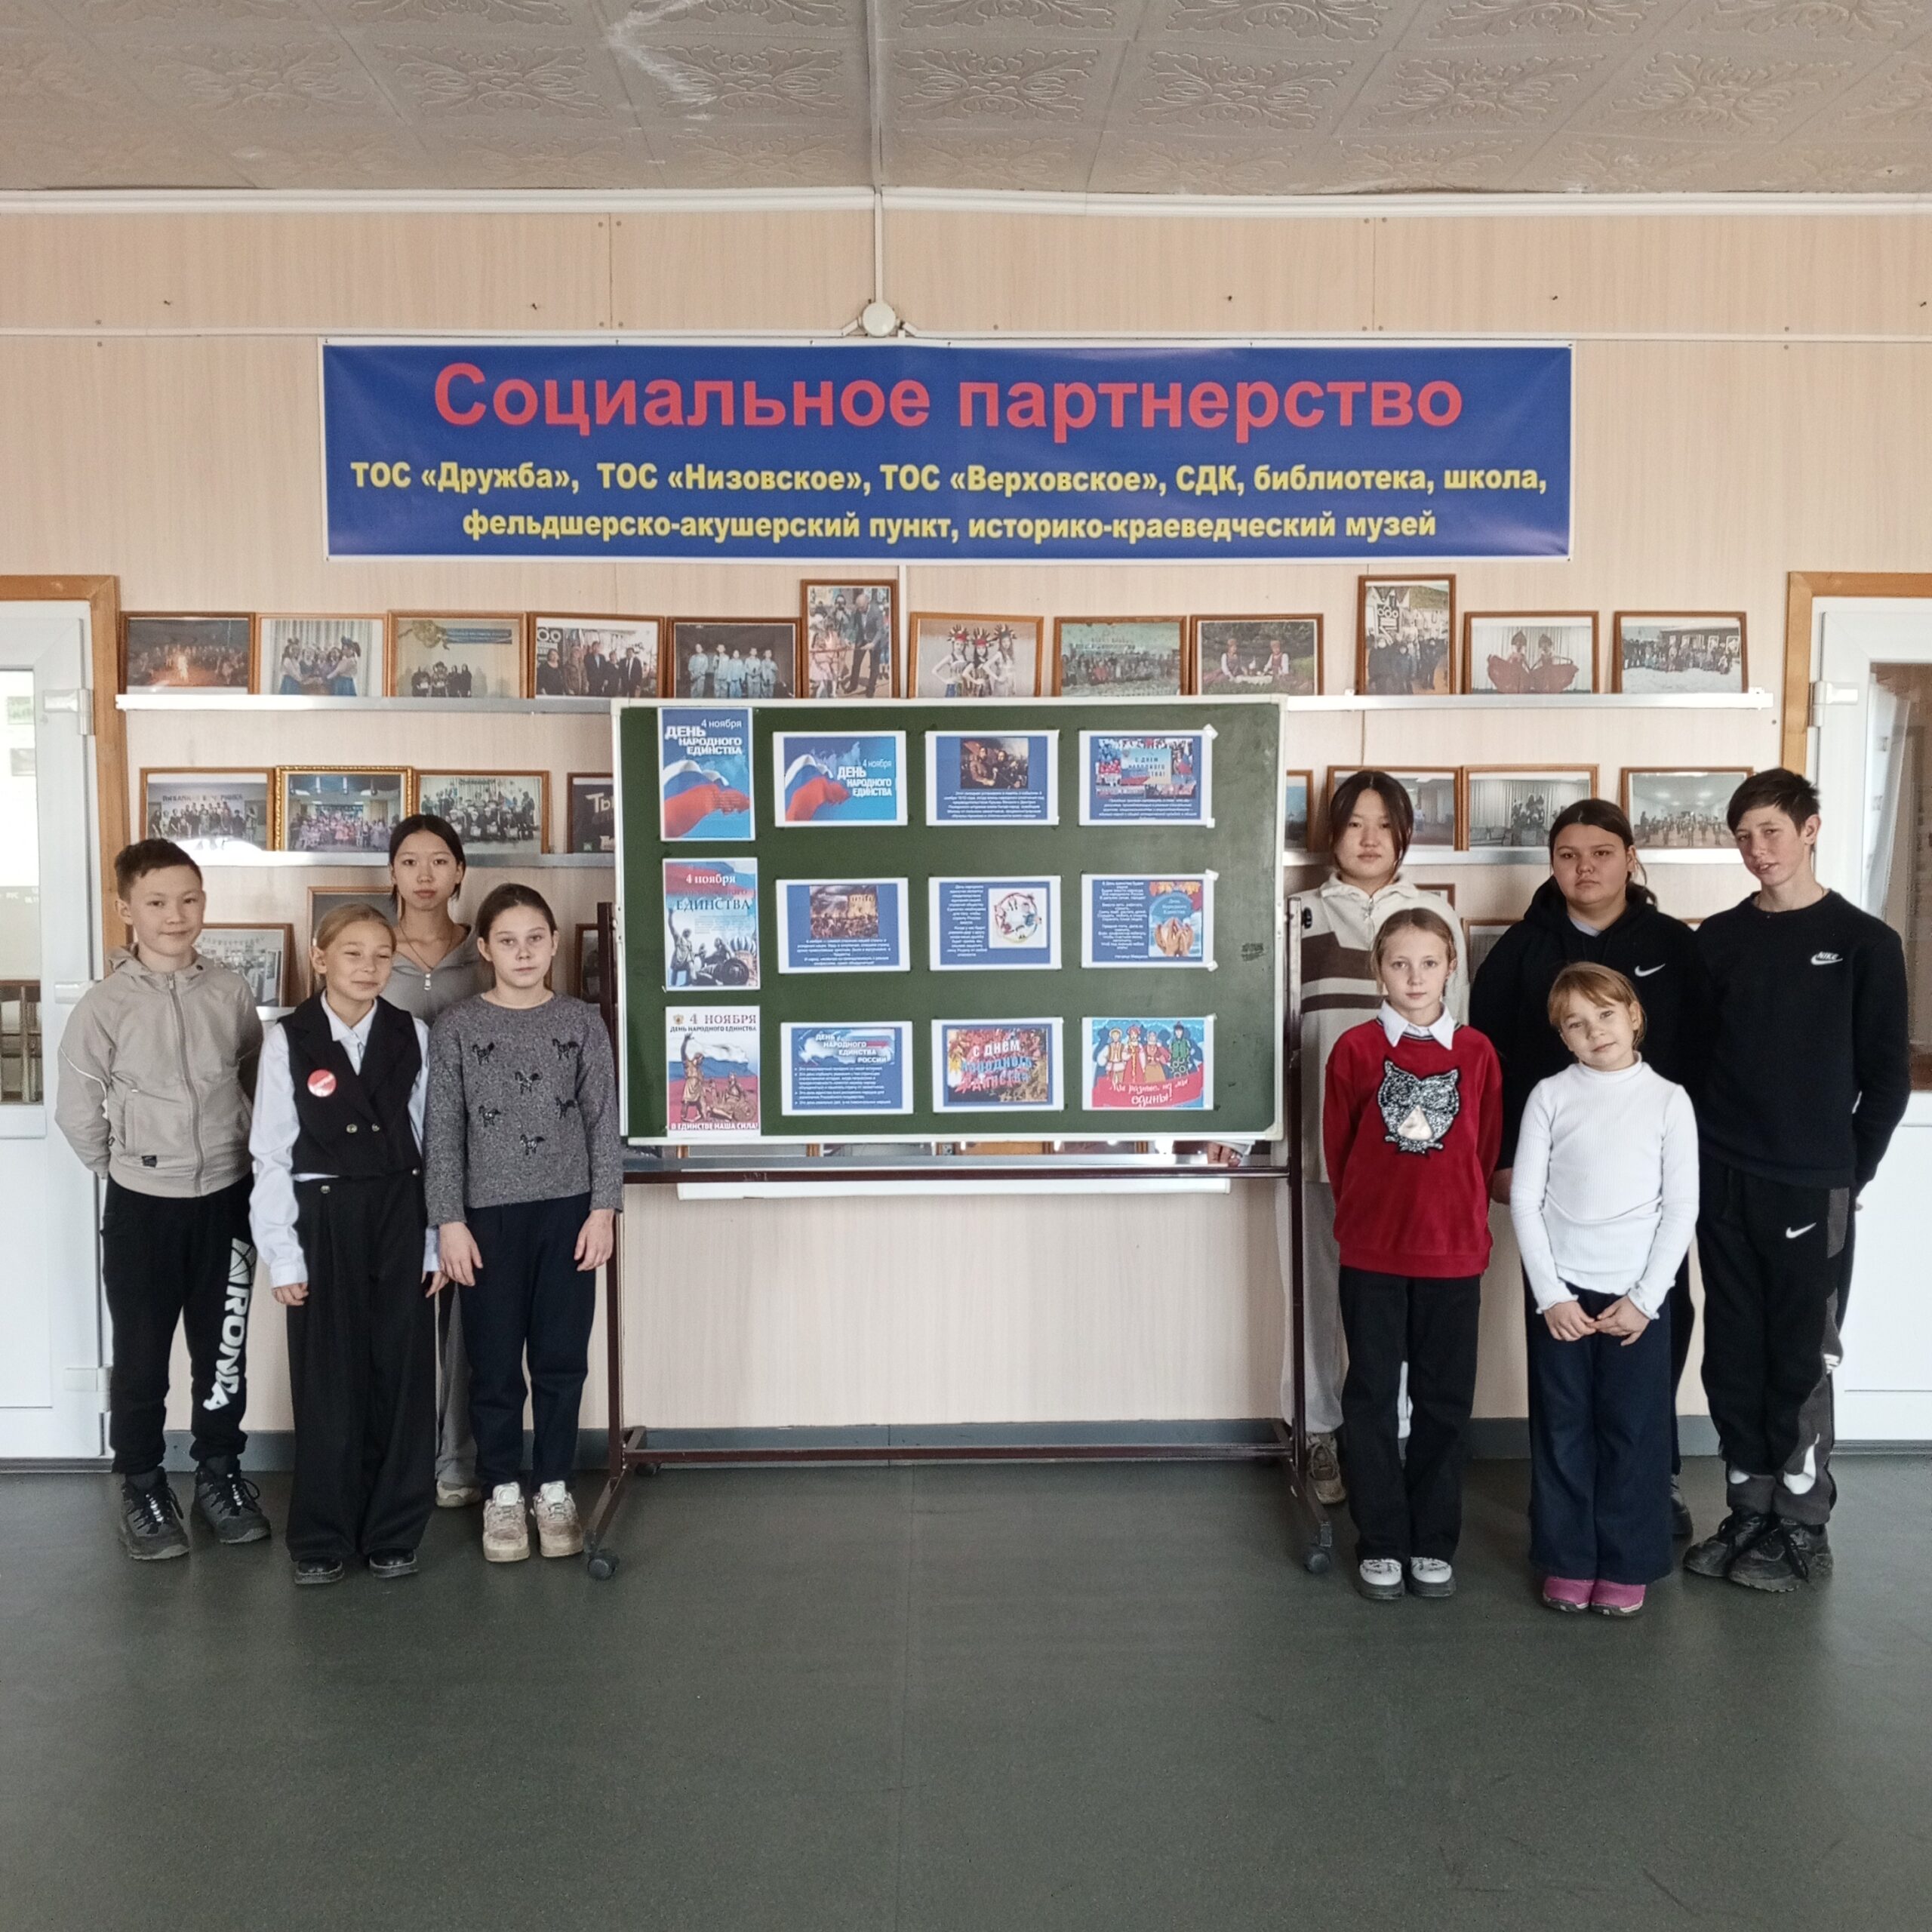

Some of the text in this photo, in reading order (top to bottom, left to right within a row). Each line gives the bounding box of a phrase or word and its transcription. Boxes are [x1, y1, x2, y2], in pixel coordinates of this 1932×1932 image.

[435, 363, 1462, 443] Социальное партнерство
[351, 462, 1546, 497] ТОС «Дружба», ТОС «Низовское», ТОС «Верховское», СДК, библиотека, школа,
[463, 509, 1436, 544] фельдшерско-акушерский пункт, историко-краеведческий музей
[701, 719, 742, 730] 4 ноября
[664, 726, 706, 740] ДЕНЬ
[678, 737, 743, 746] НАРОДНОГО
[687, 746, 743, 756] ЕДИНСТВА
[837, 766, 866, 780] ДЕНЬ
[847, 778, 891, 788] НАРОДНОГО
[686, 874, 736, 886] 4 ноября
[676, 899, 750, 912] ЕДИНСТВА
[690, 1014, 757, 1024] 4 НОЯБРЯ
